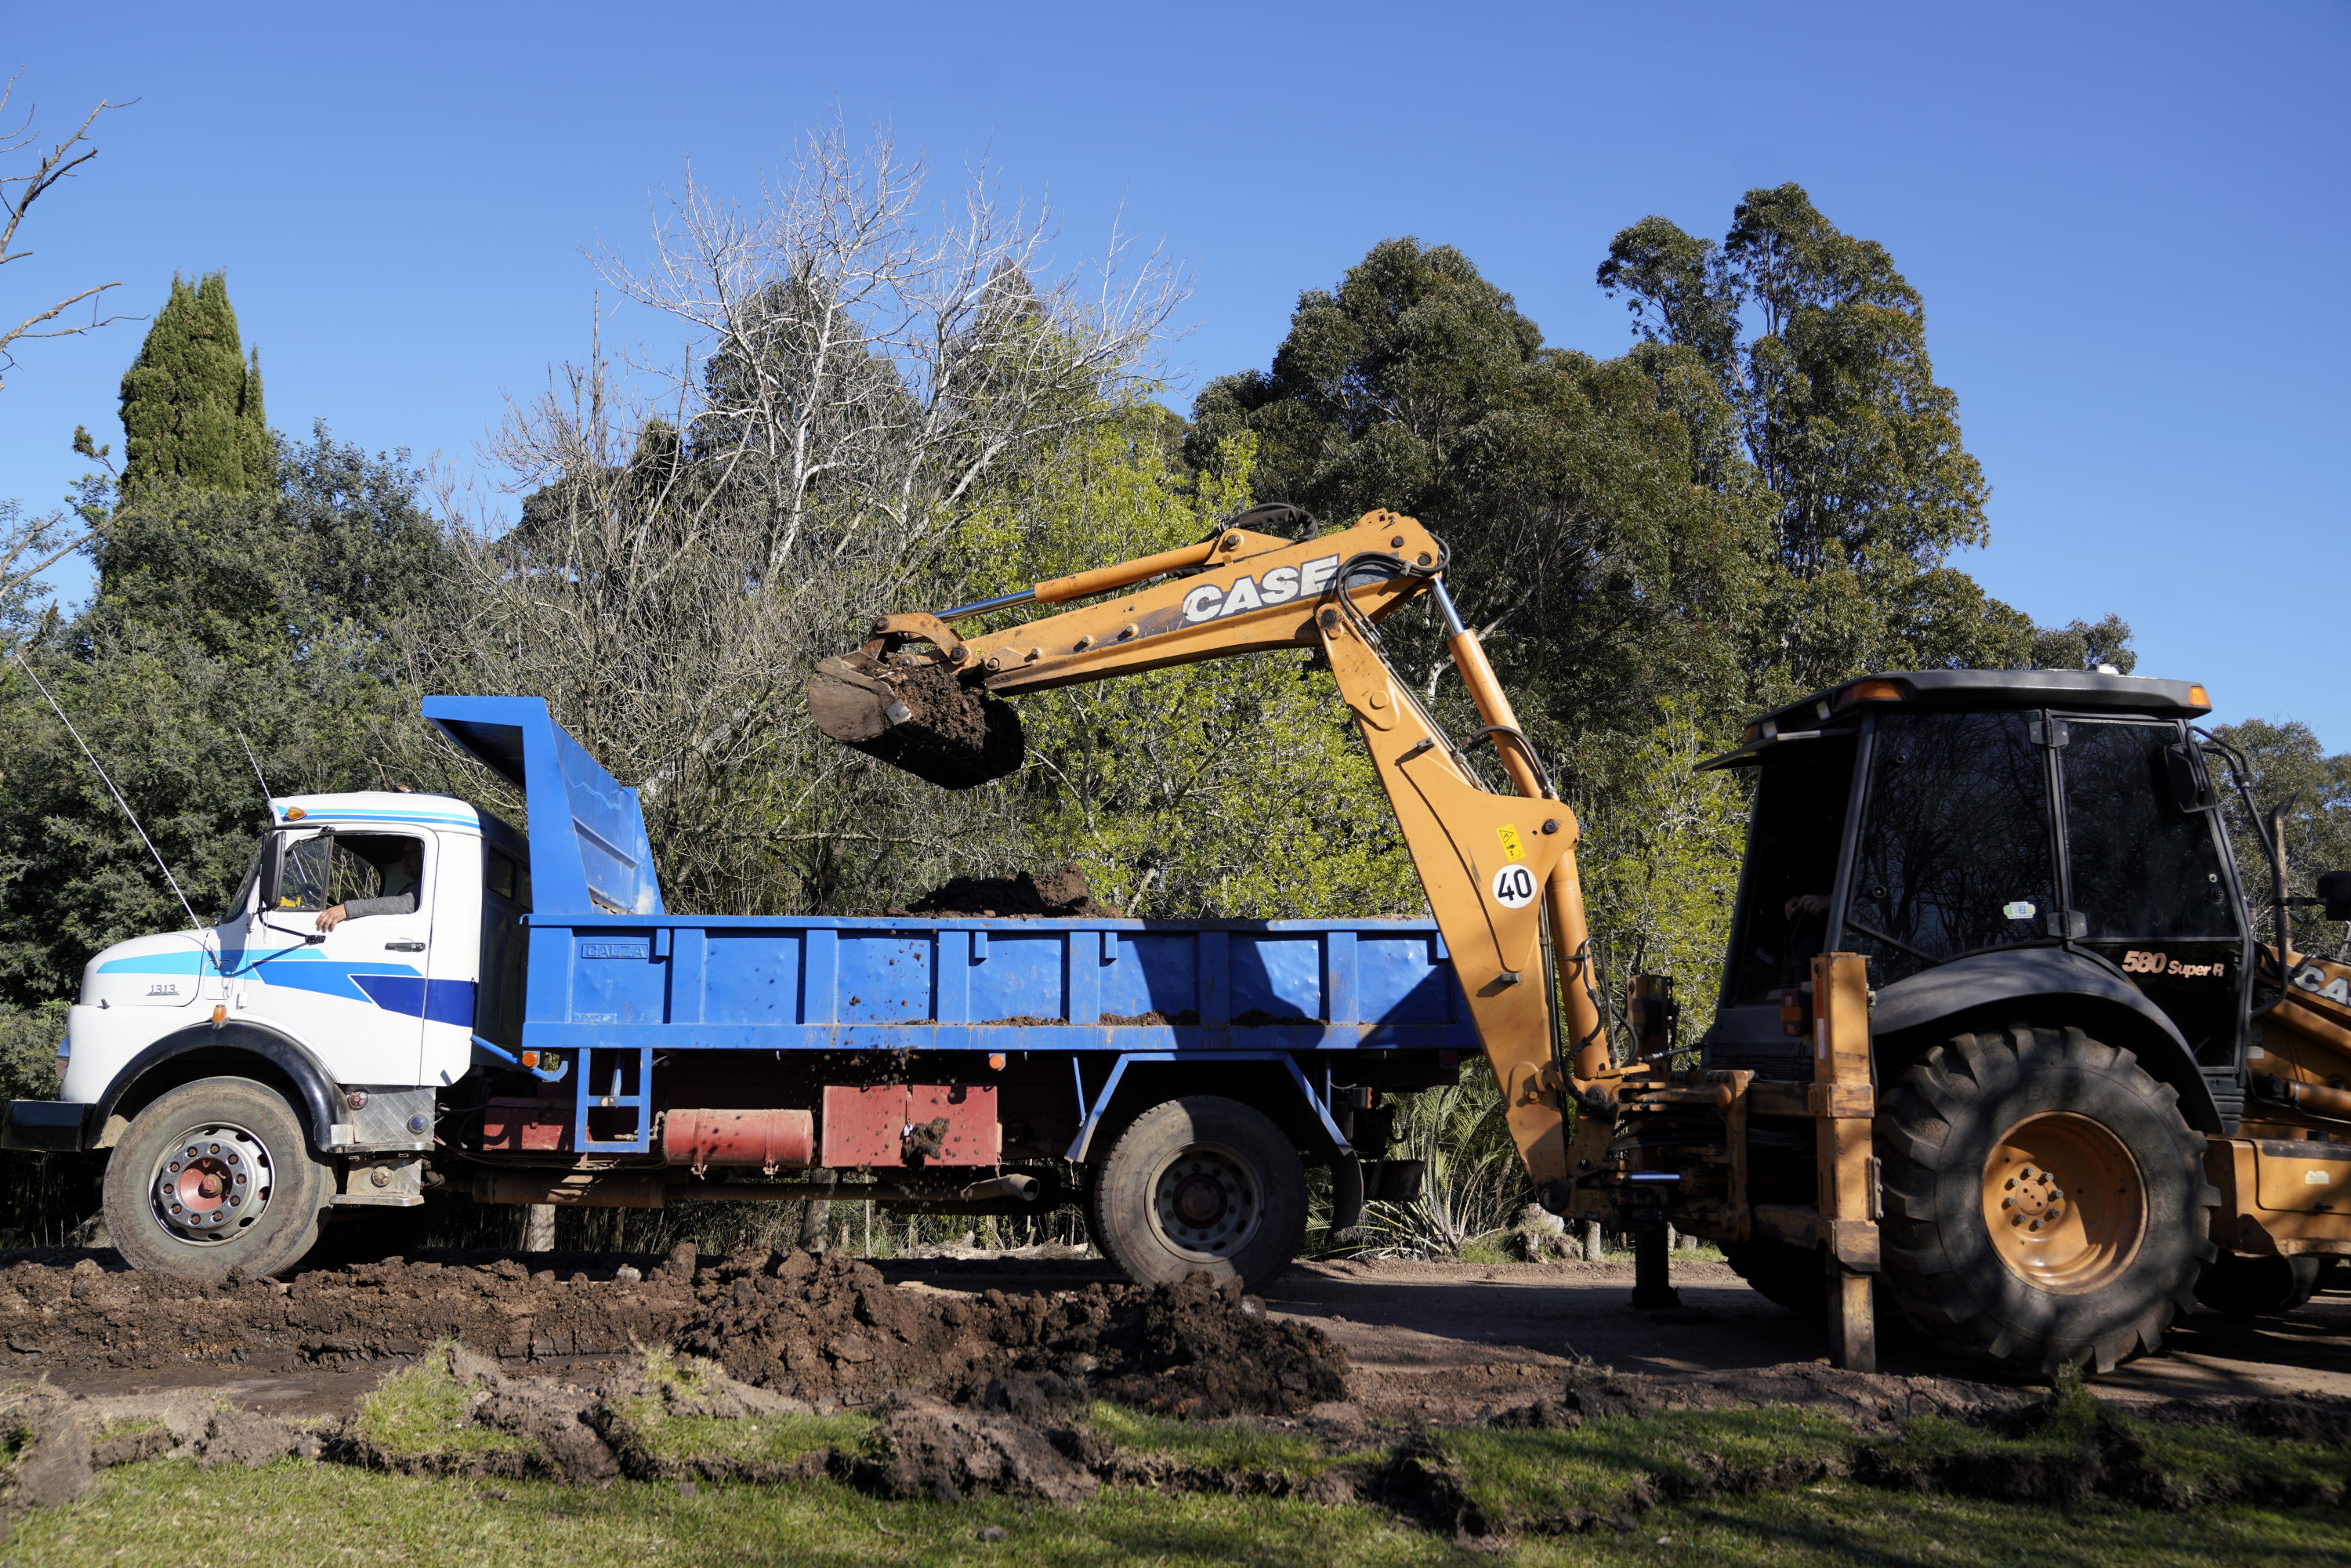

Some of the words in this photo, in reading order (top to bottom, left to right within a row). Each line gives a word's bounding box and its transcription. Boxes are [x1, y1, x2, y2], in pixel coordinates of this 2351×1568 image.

[1182, 554, 1340, 622] CASE
[1498, 868, 1532, 901] 40
[2121, 950, 2167, 973] 580
[2167, 960, 2212, 978] Super
[2212, 962, 2225, 977] R
[150, 983, 176, 994] 1313
[2294, 964, 2351, 1008] CA
